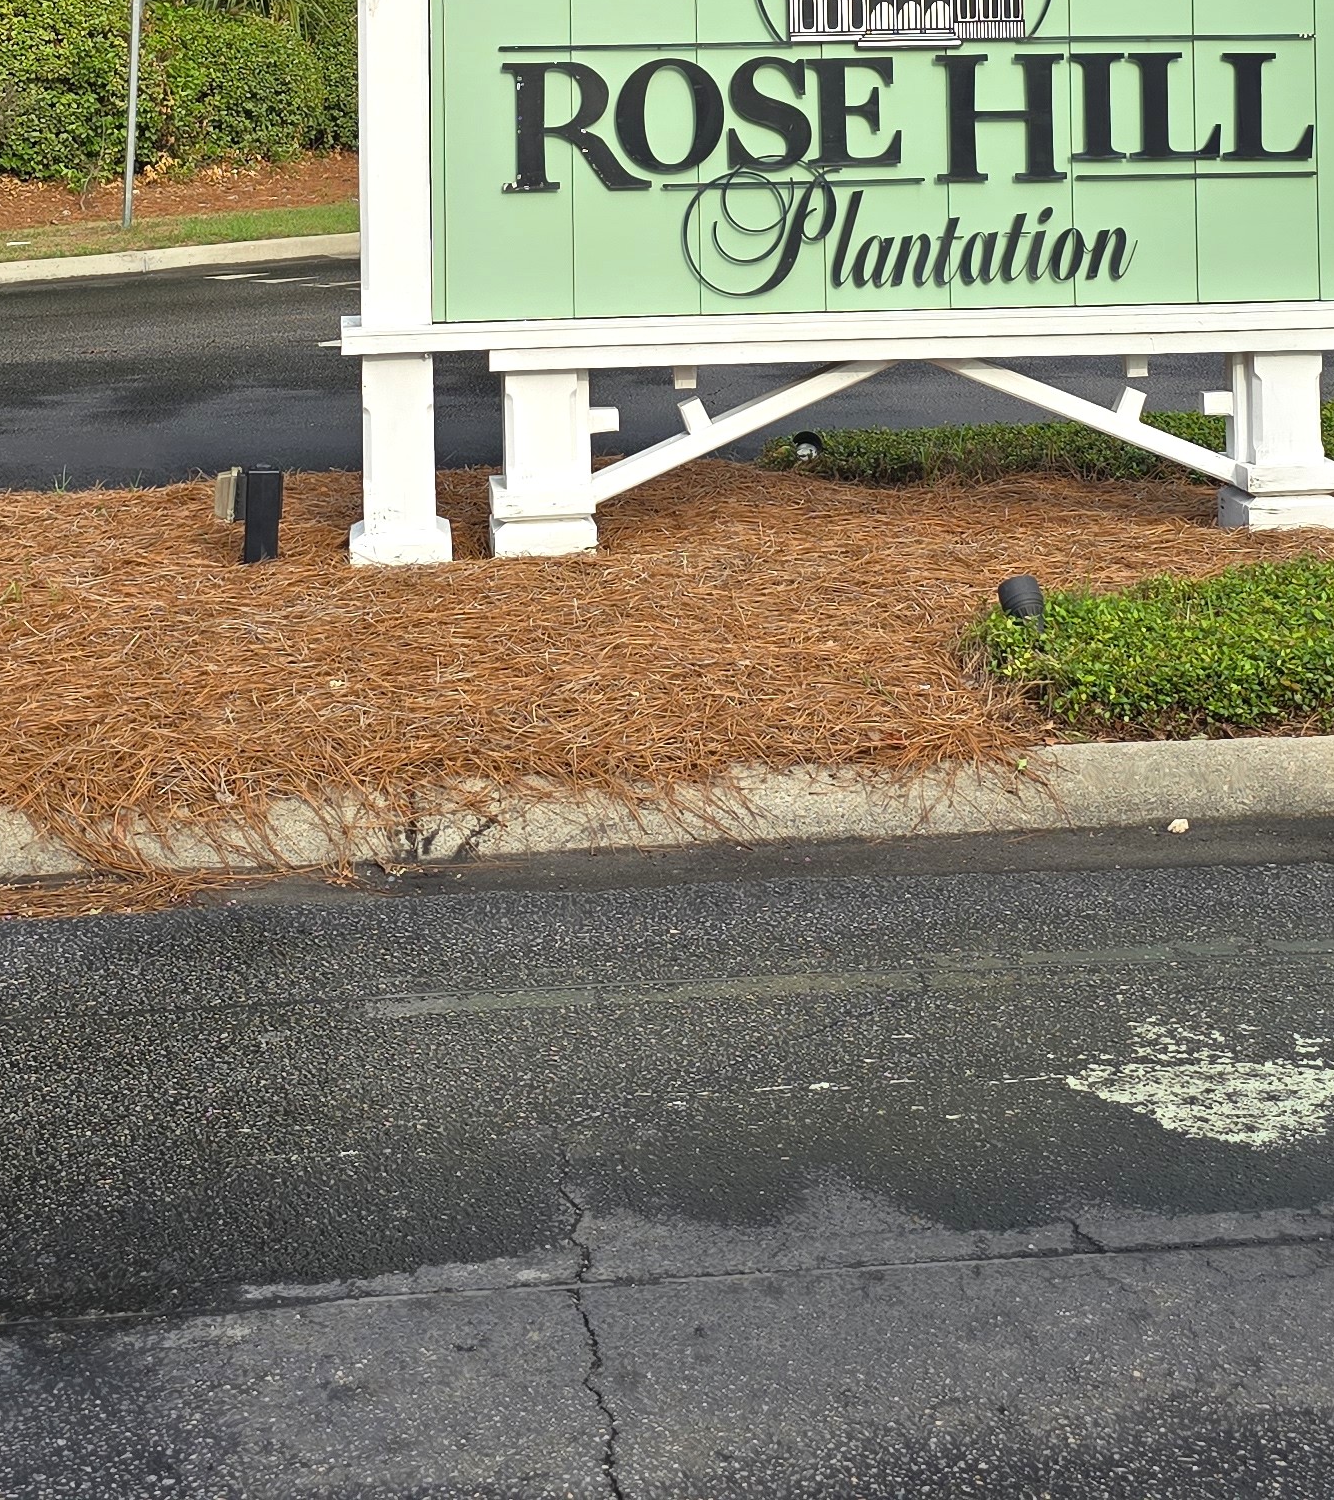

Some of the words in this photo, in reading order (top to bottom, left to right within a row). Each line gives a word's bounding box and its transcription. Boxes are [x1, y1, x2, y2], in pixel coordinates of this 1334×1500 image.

[501, 56, 903, 193] ROSE
[934, 51, 1315, 183] HILL
[682, 155, 1139, 297] Plantation
